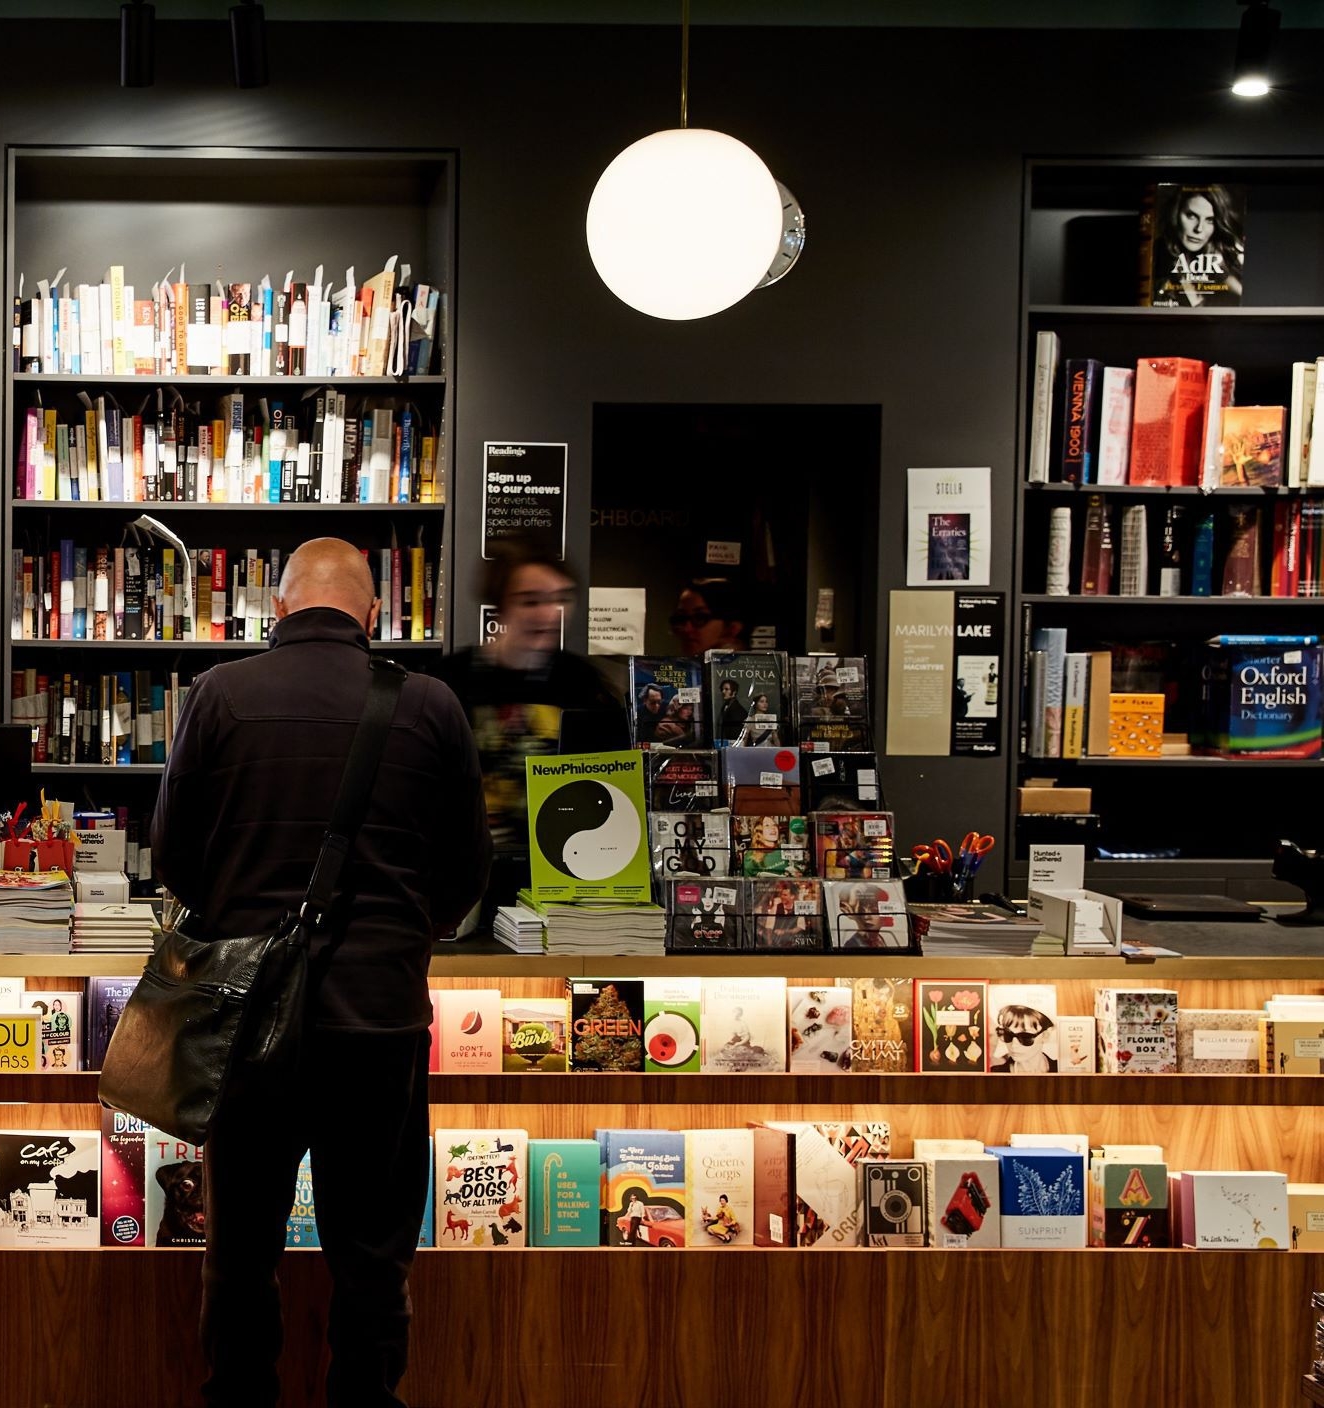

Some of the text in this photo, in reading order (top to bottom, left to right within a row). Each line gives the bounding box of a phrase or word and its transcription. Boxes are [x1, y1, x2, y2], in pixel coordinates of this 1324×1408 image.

[1171, 253, 1224, 274] AdR
[178, 331, 184, 340] TO
[1068, 370, 1086, 457] VIENNA 1900
[488, 446, 526, 457] Readings
[487, 472, 531, 484] Sign up
[487, 484, 561, 494] to our enews
[935, 482, 962, 495] STELLA
[487, 495, 501, 504] for
[487, 507, 508, 515] new
[487, 518, 552, 528] special offers
[589, 509, 690, 527] CHBOARD
[932, 516, 951, 526] The
[932, 527, 966, 537] Erratics
[895, 624, 991, 637] MARILYN LAKE
[716, 669, 775, 680] VICTORIA
[1240, 666, 1307, 685] Oxford
[1240, 686, 1307, 710] English
[1240, 709, 1294, 722] Dictionary
[532, 761, 637, 776] NewPhilosopher
[674, 821, 706, 837] OH
[675, 839, 706, 854] MY
[894, 1006, 905, 1014] 25
[573, 1018, 642, 1036] GREEN
[510, 1031, 558, 1050] Burbs
[1126, 1036, 1166, 1044] FLOWER
[850, 1050, 904, 1061] KLIMT
[20, 1140, 70, 1159] Cafe
[628, 1146, 645, 1155] Very
[627, 1161, 675, 1172] Dad Jokes
[463, 1165, 507, 1182] BEST
[705, 1168, 741, 1180] Corgis
[461, 1181, 508, 1199] DOGS
[1119, 1168, 1153, 1206] A
[462, 1197, 507, 1208] OF ALL TIME
[557, 1201, 590, 1209] WALKING
[557, 1211, 579, 1219] STICK
[1018, 1226, 1067, 1236] SUNPRINT
